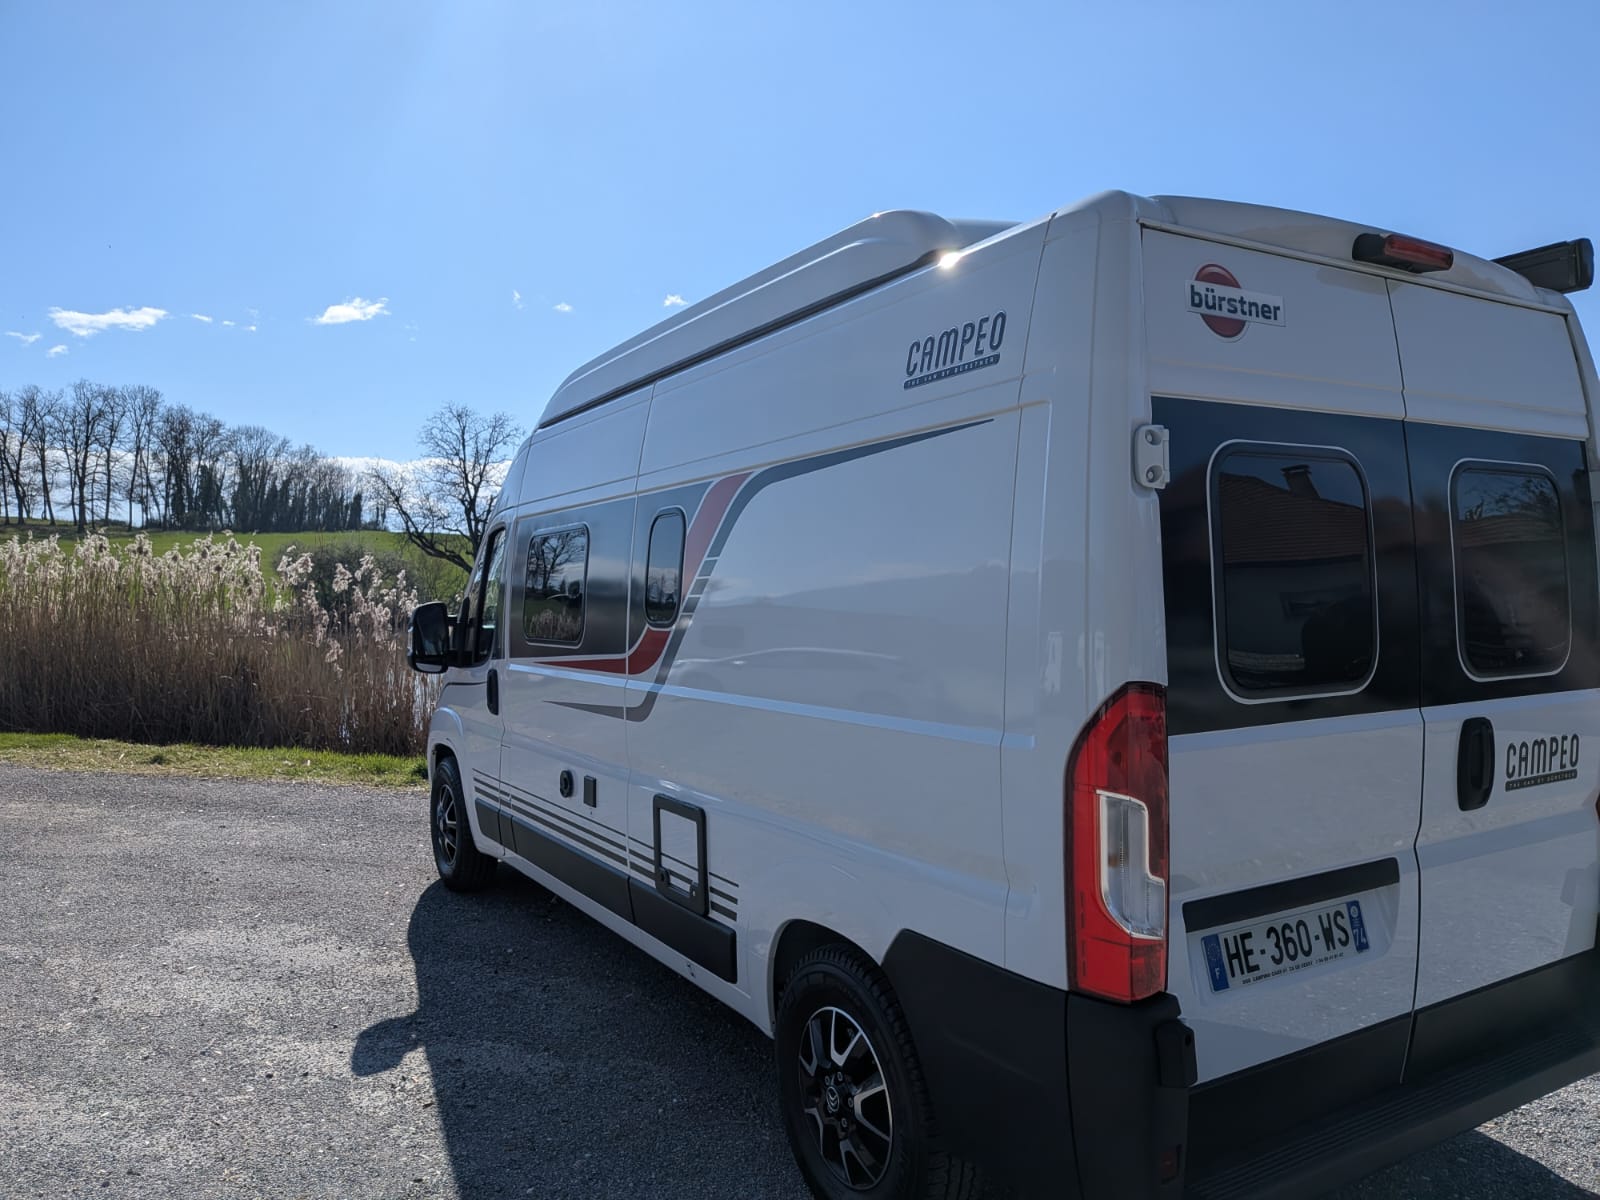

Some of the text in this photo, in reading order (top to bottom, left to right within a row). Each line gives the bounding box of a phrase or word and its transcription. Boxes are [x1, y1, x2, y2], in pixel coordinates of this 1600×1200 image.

[1190, 284, 1280, 321] bürstner
[906, 311, 1006, 376] CAMPEO
[1506, 733, 1579, 779] CAMPEO
[1223, 910, 1350, 978] HE-360-WS
